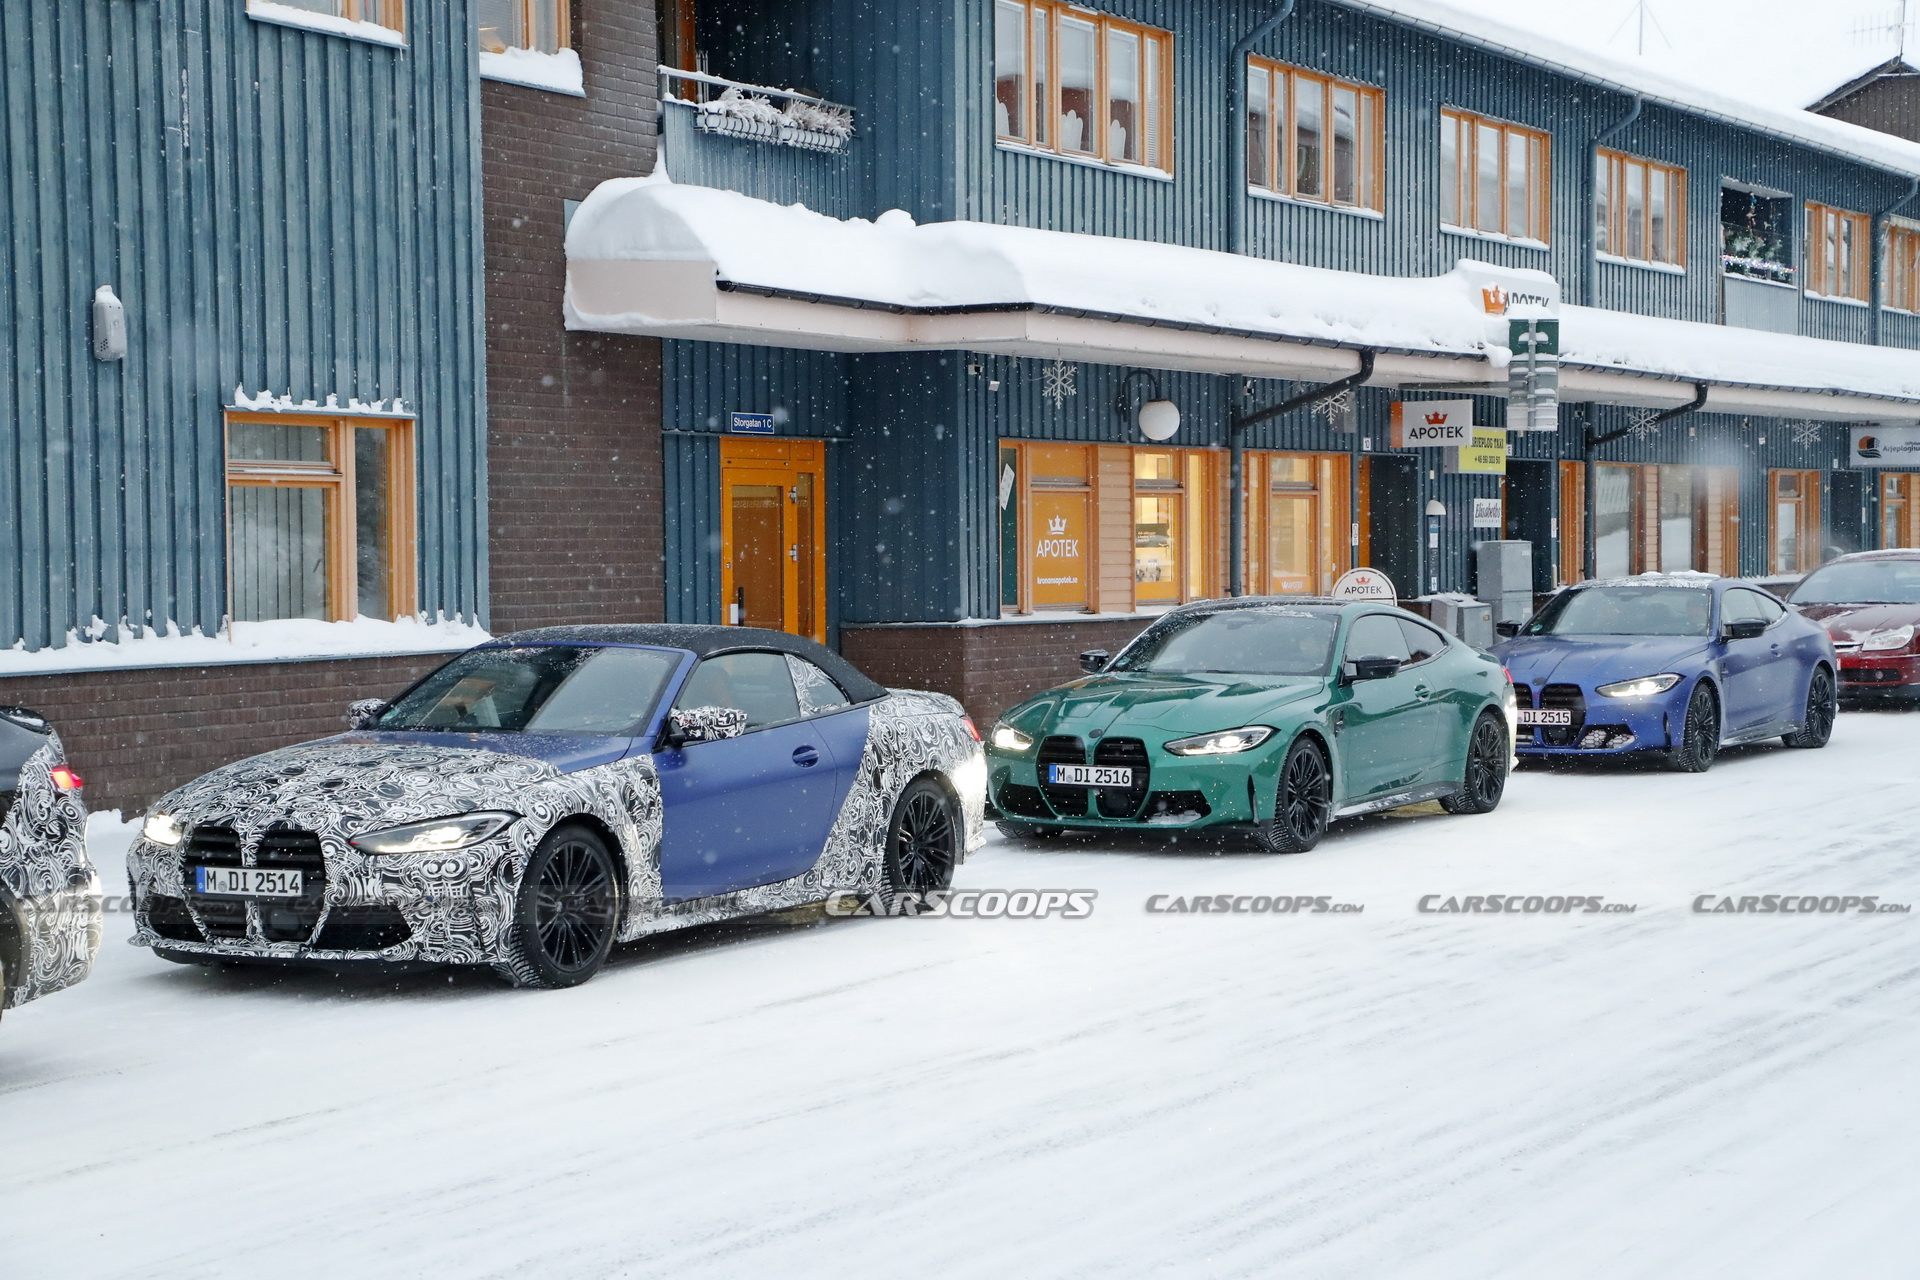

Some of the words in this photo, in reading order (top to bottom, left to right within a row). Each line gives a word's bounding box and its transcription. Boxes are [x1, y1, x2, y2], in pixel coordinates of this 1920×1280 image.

[733, 417, 761, 428] Storgatan
[762, 419, 766, 428] 1
[766, 419, 772, 428] C
[1408, 426, 1464, 440] APOTEK
[1036, 539, 1079, 558] APOTEK
[1344, 585, 1382, 595] APOTEK
[1523, 711, 1537, 723] DI
[1541, 712, 1570, 724] 2515
[1057, 767, 1066, 782] M
[1074, 768, 1091, 783] DI
[1095, 769, 1130, 785] 2516
[206, 870, 217, 891] M
[228, 871, 249, 892] DI
[255, 872, 300, 894] 2514
